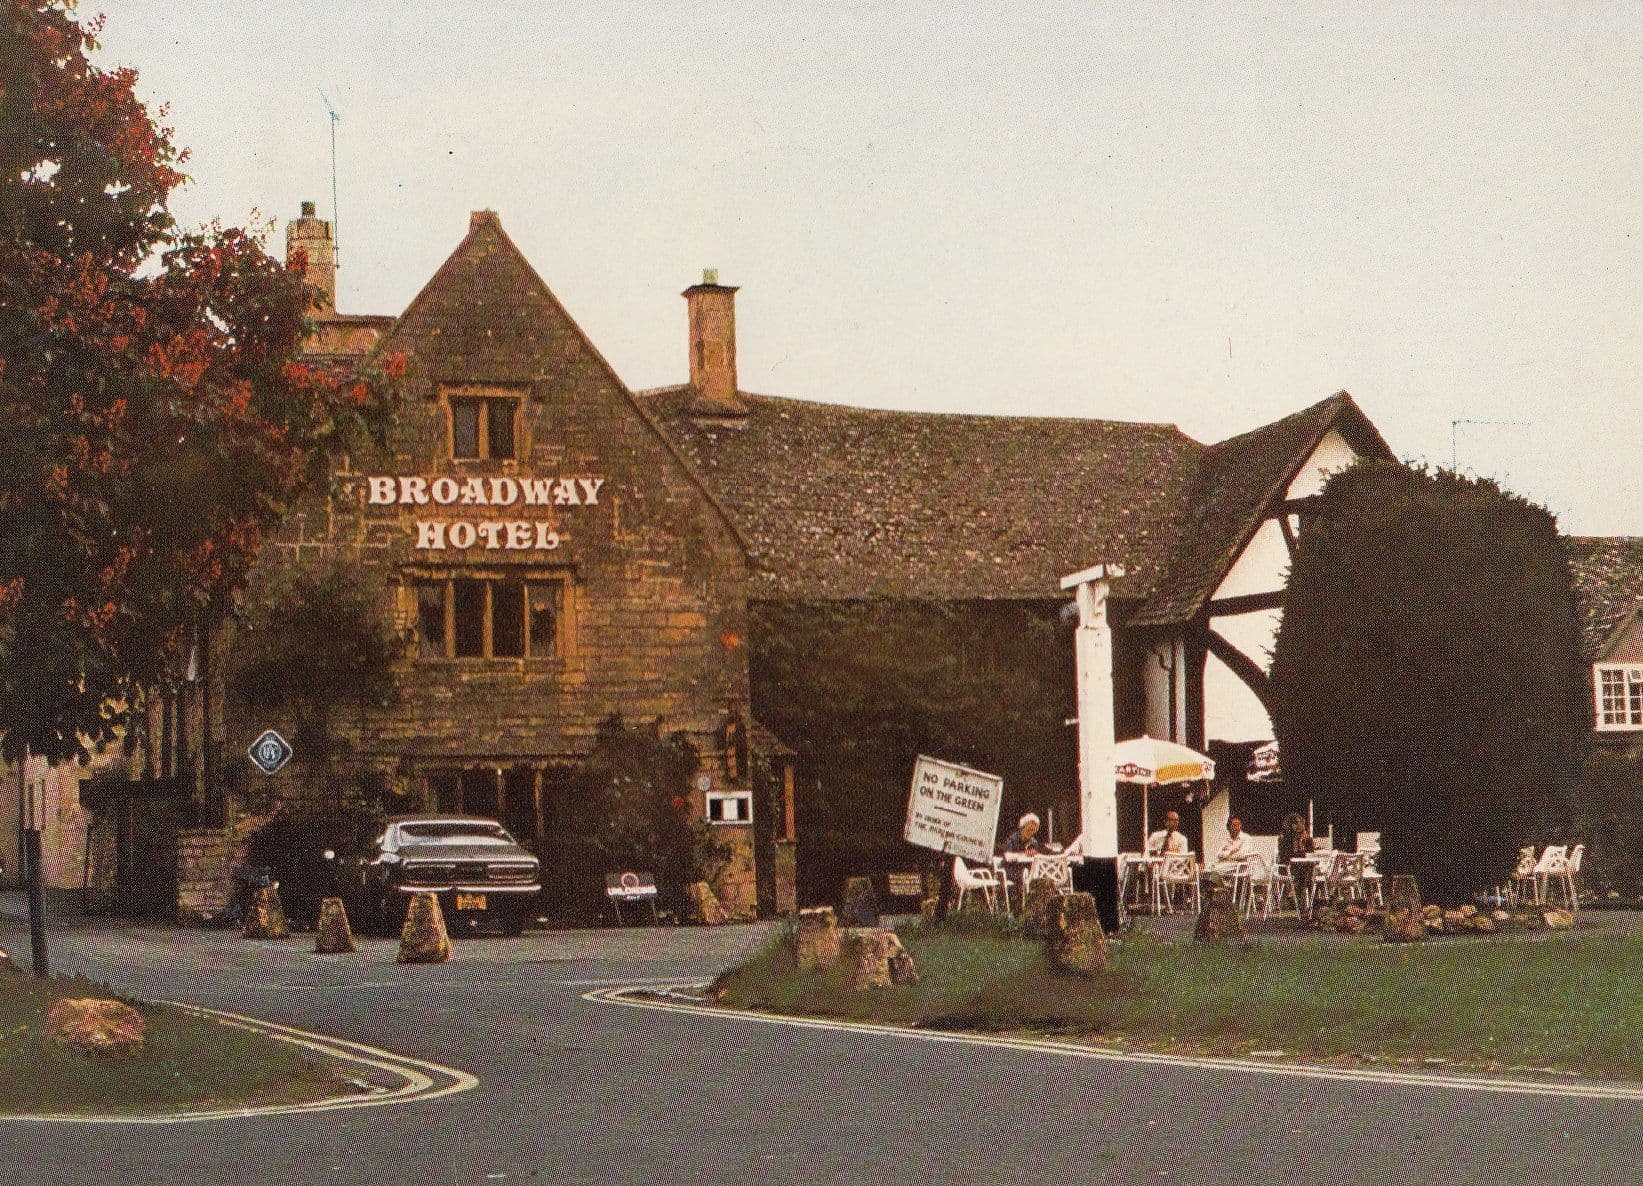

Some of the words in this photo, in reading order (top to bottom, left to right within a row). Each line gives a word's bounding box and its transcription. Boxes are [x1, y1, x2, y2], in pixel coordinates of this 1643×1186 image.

[368, 476, 605, 505] BROADWAY
[416, 521, 560, 550] HOTEL
[919, 785, 934, 799] ON
[936, 789, 952, 803] THE
[954, 796, 984, 812] GREEN
[923, 771, 938, 785] NO
[943, 778, 990, 799] PARKING
[915, 821, 927, 830] THE
